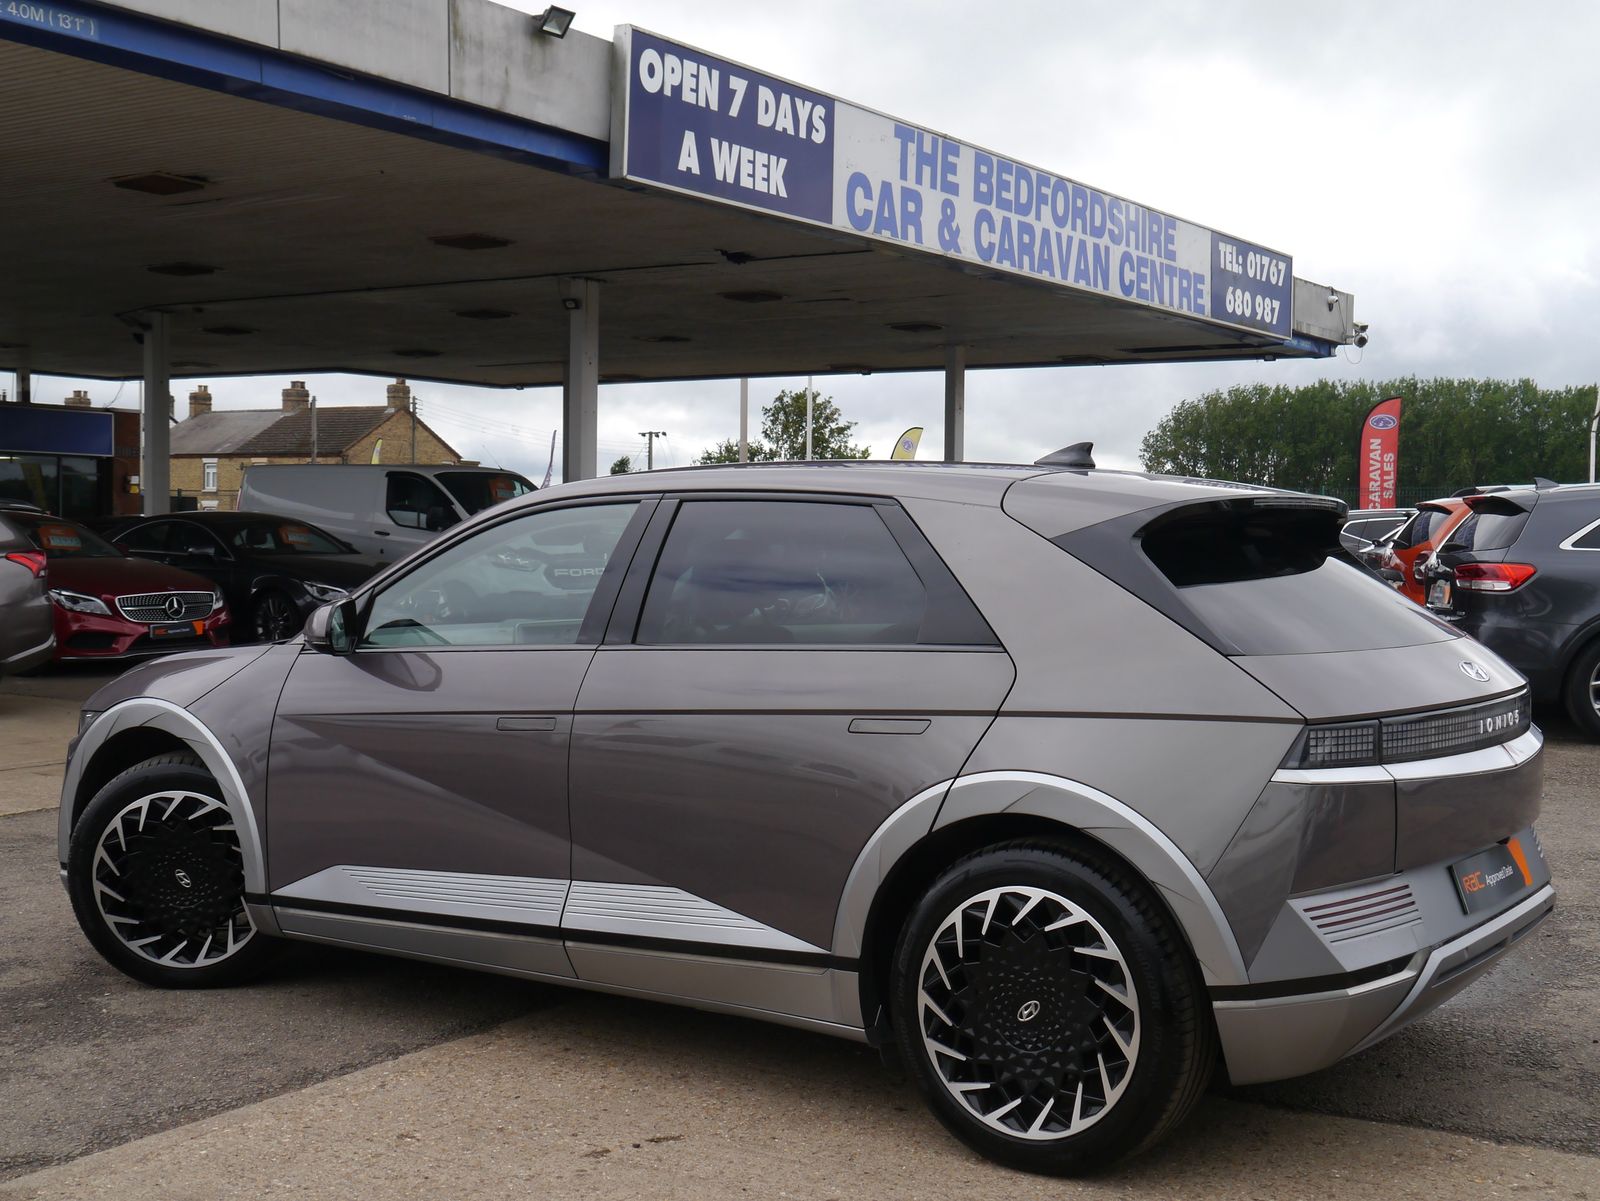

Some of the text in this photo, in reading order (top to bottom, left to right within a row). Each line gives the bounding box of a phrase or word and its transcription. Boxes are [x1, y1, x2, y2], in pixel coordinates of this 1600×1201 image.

[7, 1, 44, 23] 4.0M
[639, 48, 826, 144] OPEN 7 DAYS
[677, 130, 788, 198] A WEEK
[894, 123, 1177, 262] THE BEDFORDSHIRE
[846, 171, 1205, 316] CAR & CARAVAN CENTRE
[1218, 240, 1287, 287] TEL: 01767
[1226, 286, 1281, 325] 680 987
[1369, 438, 1382, 511] CARAVAN
[1383, 452, 1395, 499] SALES
